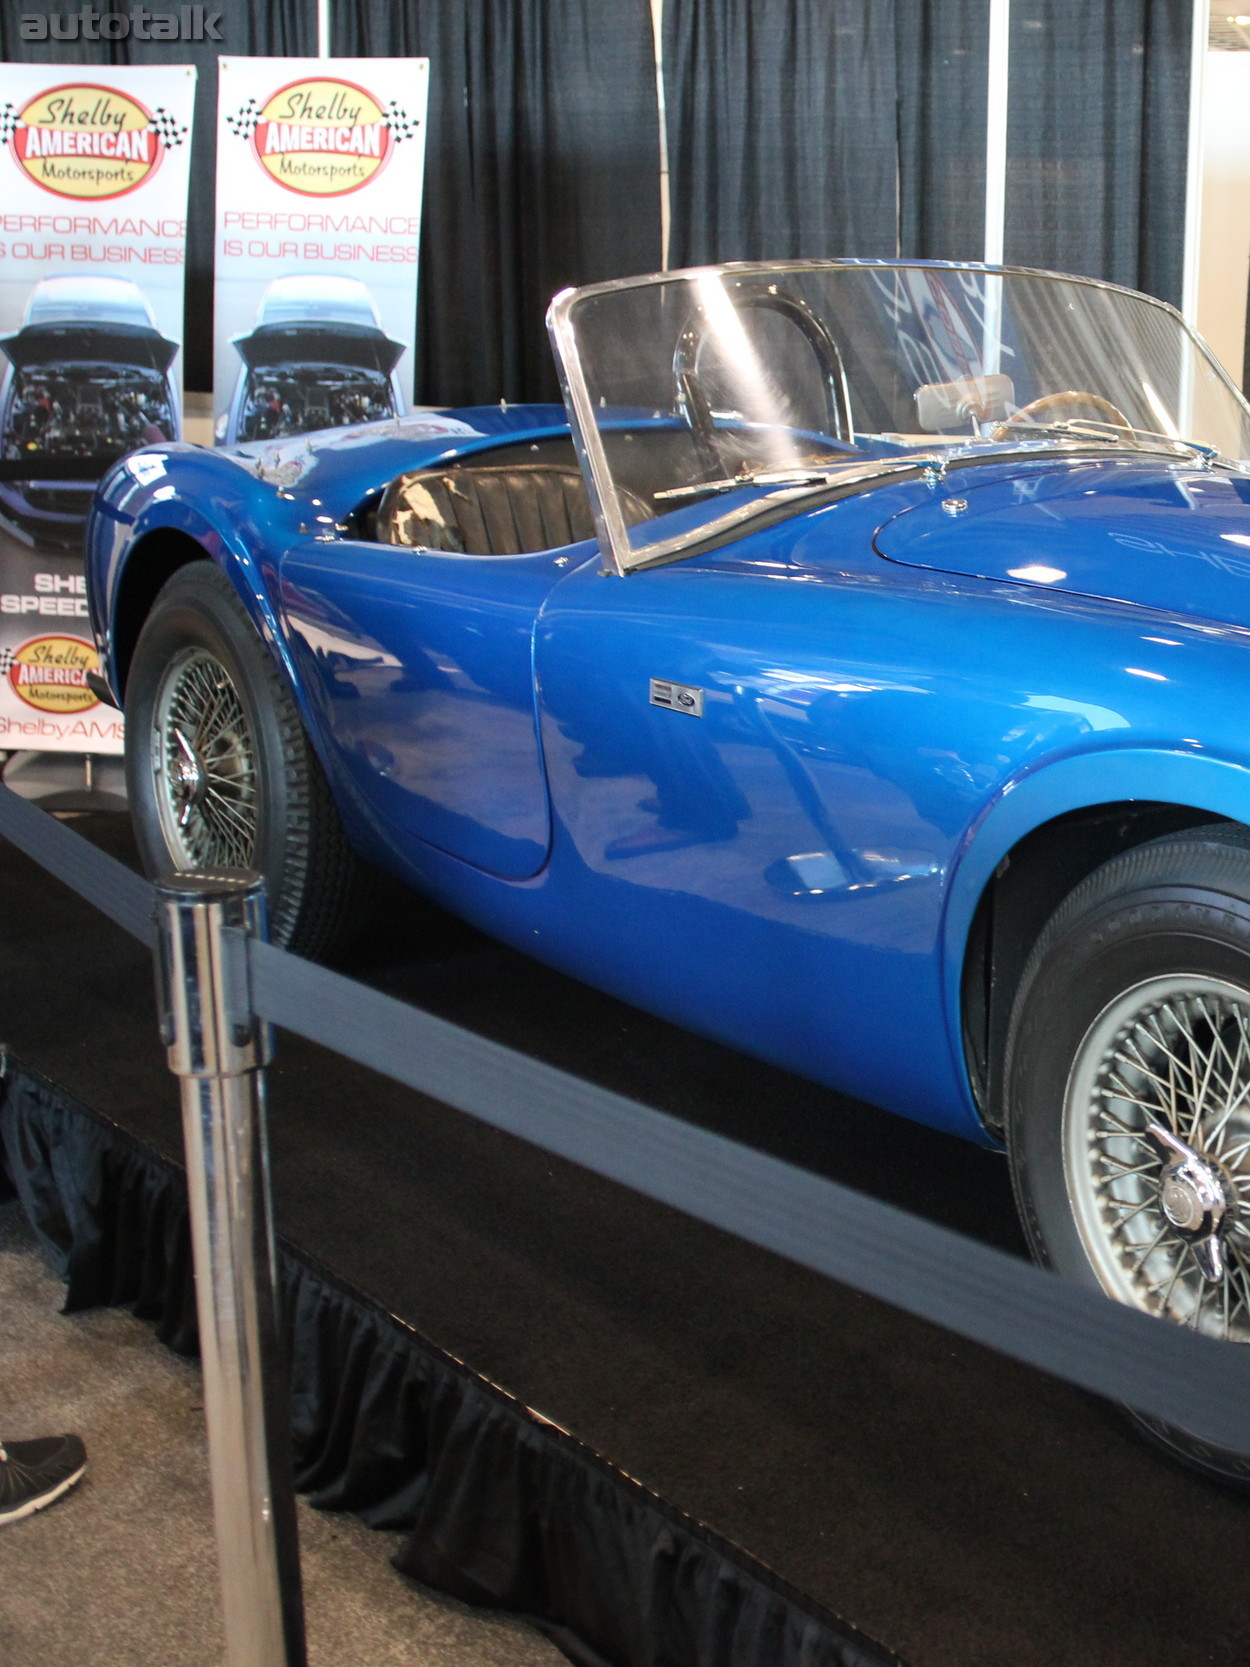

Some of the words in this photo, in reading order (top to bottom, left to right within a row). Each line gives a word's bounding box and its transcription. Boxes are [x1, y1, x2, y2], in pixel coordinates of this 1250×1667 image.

[38, 97, 127, 132] Shelby
[278, 92, 362, 127] Shelby
[25, 125, 149, 162] AMERICAN
[265, 121, 381, 157] AMERICAN
[41, 156, 134, 186] Motorsports
[279, 152, 365, 181] Motorsports
[224, 211, 419, 235] PERFORMANCE
[11, 242, 65, 260] OUR
[224, 240, 243, 257] IS
[248, 241, 299, 259] OUR
[304, 243, 418, 263] BUSINESS
[27, 644, 89, 669] Shelby
[28, 686, 95, 704] Motorsports
